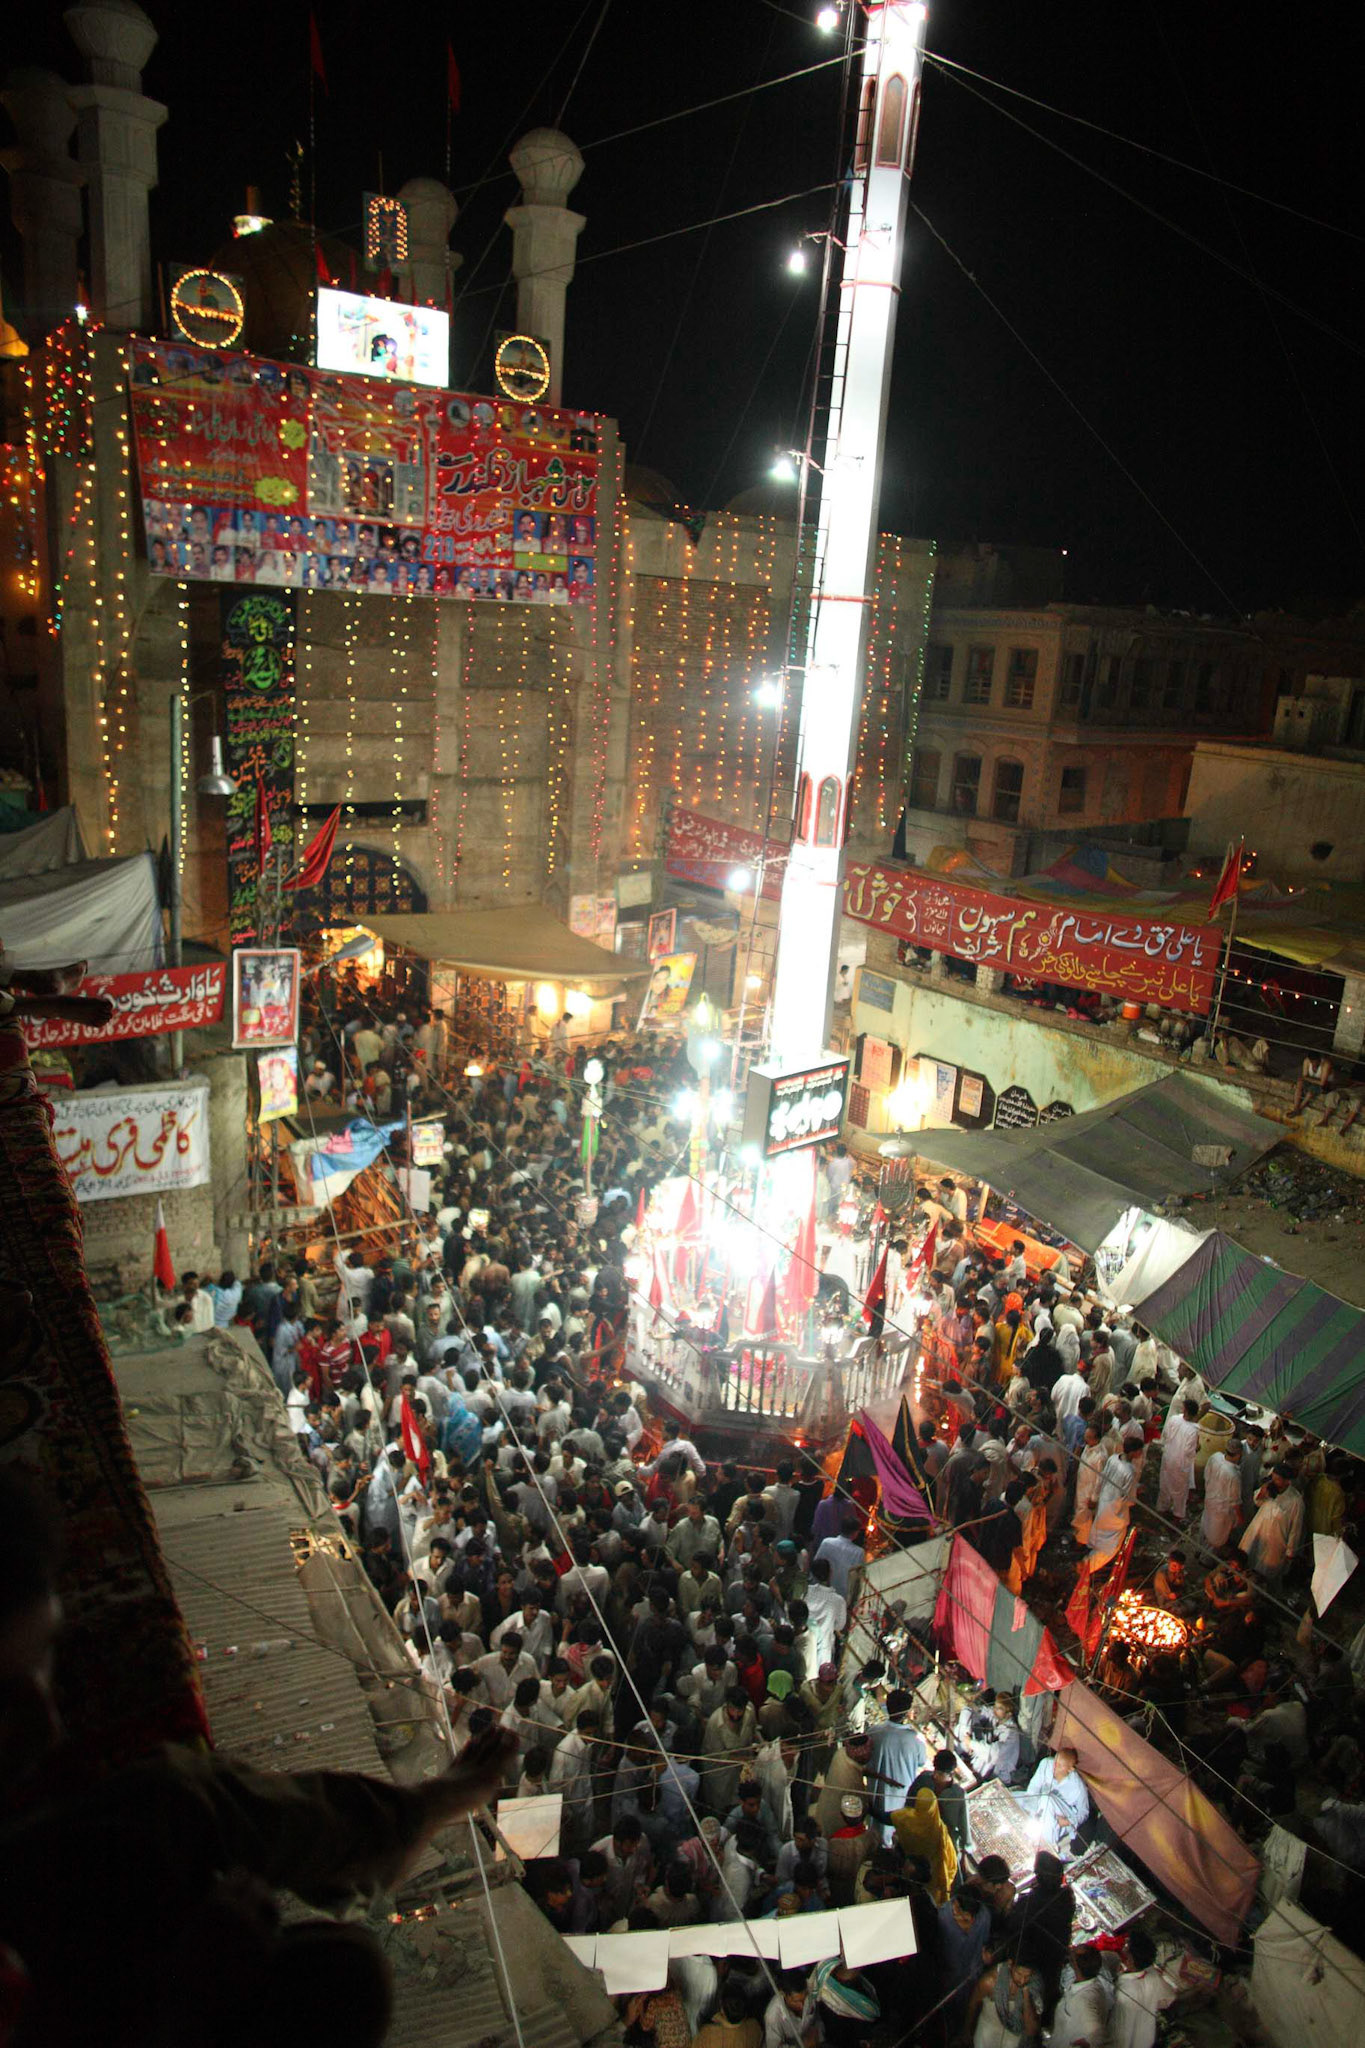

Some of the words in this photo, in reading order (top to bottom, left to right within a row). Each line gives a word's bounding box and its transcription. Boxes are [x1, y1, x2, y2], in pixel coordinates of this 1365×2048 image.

[442, 448, 511, 494] قلندر
[958, 904, 1016, 934] سہون
[952, 934, 1004, 962] شریف
[1144, 926, 1176, 956] حق
[1165, 927, 1196, 962] علی
[1190, 935, 1204, 967] یا
[205, 967, 222, 1005] یا
[1159, 969, 1188, 1001] علی
[1189, 974, 1205, 1008] یا
